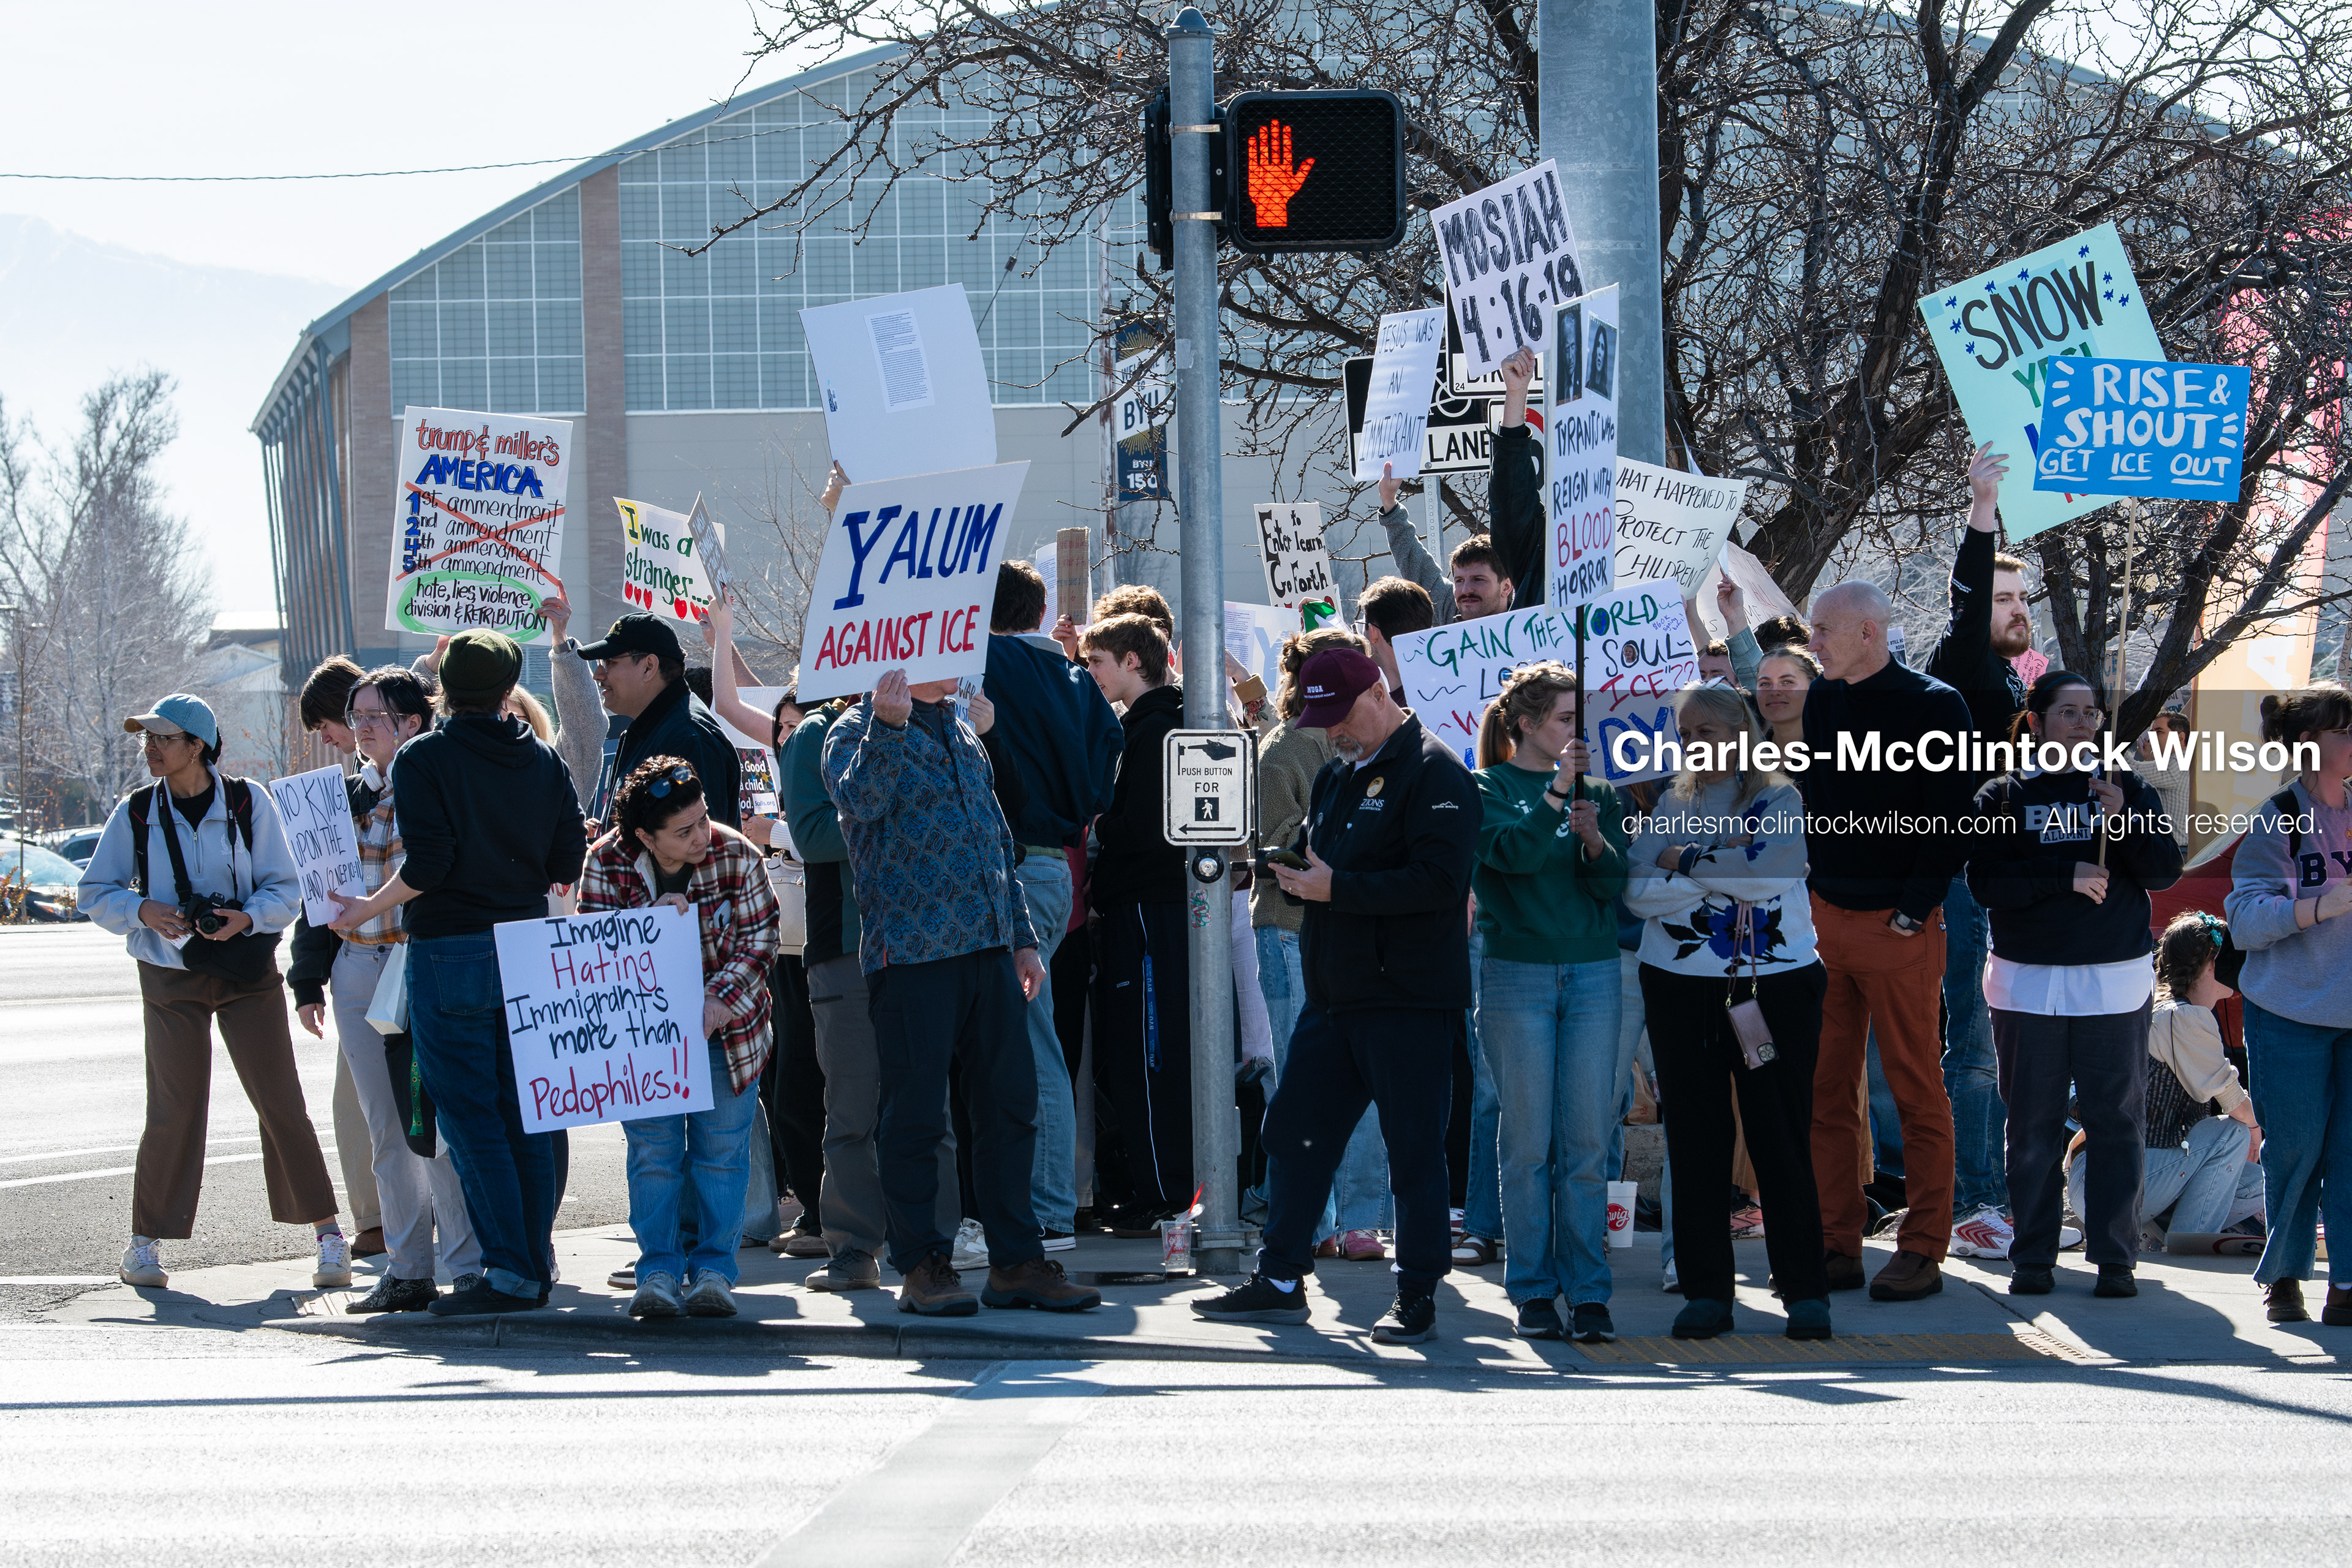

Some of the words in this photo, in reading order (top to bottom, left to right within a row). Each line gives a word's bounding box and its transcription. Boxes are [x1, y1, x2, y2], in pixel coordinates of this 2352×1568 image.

[1439, 170, 1569, 288] MOSIAH
[1461, 254, 1583, 363] 4:16-19
[1961, 260, 2103, 370] SNOW
[1379, 320, 1409, 354] JESUS
[1415, 317, 1434, 343] WAS
[1388, 366, 1404, 398] AN
[1455, 382, 1465, 391] 24
[2092, 363, 2207, 409] RISE
[2209, 374, 2232, 405] &
[1125, 390, 1159, 431] BYU
[2055, 407, 2218, 449] SHOUT
[416, 418, 476, 460] trump
[475, 424, 491, 460] &
[494, 431, 559, 466] miller's
[1359, 415, 1425, 462] IMMIGRANT
[1428, 429, 1490, 462] LANE
[1555, 410, 1600, 456] TYRANTS
[1601, 415, 1615, 444] WHO
[415, 454, 544, 499] AMERICA
[2038, 448, 2095, 475] GET
[2111, 451, 2154, 474] ICE
[2170, 453, 2233, 478] OUT
[405, 490, 442, 516] 1st
[447, 497, 564, 527] ammendment
[1553, 467, 1588, 520] REIGN
[1593, 467, 1612, 499] WITH
[1616, 467, 1653, 492] HAT
[1653, 476, 1724, 509] HAPPENED
[1725, 490, 1738, 511] TO
[405, 512, 437, 537] 2nd
[445, 519, 560, 551] ammendment
[620, 505, 638, 540] I
[640, 524, 670, 550] was
[677, 537, 693, 557] a
[1258, 509, 1292, 563] Enter
[1294, 530, 1326, 553] learn,
[1291, 510, 1302, 527] to
[1558, 507, 1612, 567] BLOOD
[1690, 528, 1714, 550] THE
[402, 553, 431, 574] 5th
[404, 532, 434, 556] 4th
[443, 538, 551, 571] ammendment
[833, 502, 1004, 611] YALUM
[416, 577, 450, 601] hate,
[479, 583, 534, 609] violence,
[1558, 556, 1608, 608] HORROR
[404, 597, 451, 619] division
[464, 603, 548, 631] RETRIBUTION
[1523, 611, 1564, 653] THE
[1561, 594, 1659, 643] WORLD
[815, 610, 933, 671] AGAINST
[939, 605, 980, 655] ICE
[1602, 633, 1693, 677] SOUL
[1306, 685, 1324, 693] MUGA
[744, 760, 766, 772] Good
[745, 778, 764, 791] child
[1182, 767, 1203, 777] PUSH
[1205, 766, 1233, 777] BUTTON
[275, 783, 300, 826] NO
[300, 773, 349, 832] KINGS
[739, 799, 754, 809] od.
[1194, 782, 1219, 793] FOR
[1360, 798, 1385, 808] ZIONS
[2023, 801, 2102, 831] BYU
[2043, 827, 2090, 843] ALUMNI
[291, 827, 323, 868] UPON
[319, 824, 346, 856] THE
[301, 869, 324, 905] LAND
[545, 911, 661, 951] Imagine
[551, 949, 655, 992] Hating
[506, 983, 669, 1036] Immigrants
[549, 1019, 616, 1060] more
[631, 1004, 681, 1044] than
